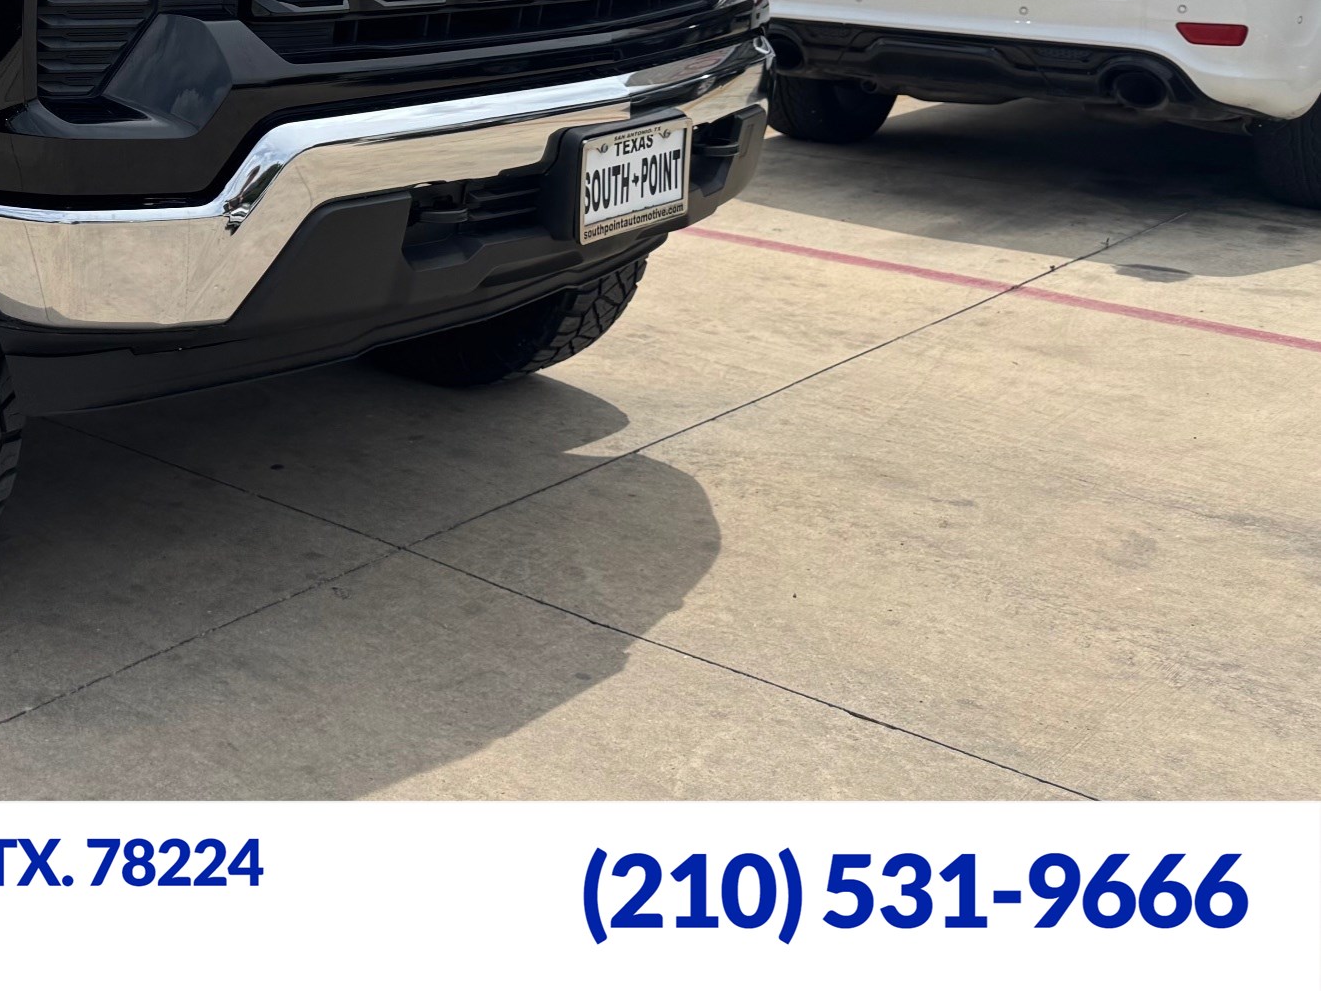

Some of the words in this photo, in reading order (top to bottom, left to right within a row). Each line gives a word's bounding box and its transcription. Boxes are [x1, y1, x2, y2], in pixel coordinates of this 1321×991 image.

[614, 134, 654, 157] TEXAS
[584, 162, 631, 215] SOUTH
[640, 148, 681, 199] POINT
[583, 202, 684, 240] southpointautomotive.com
